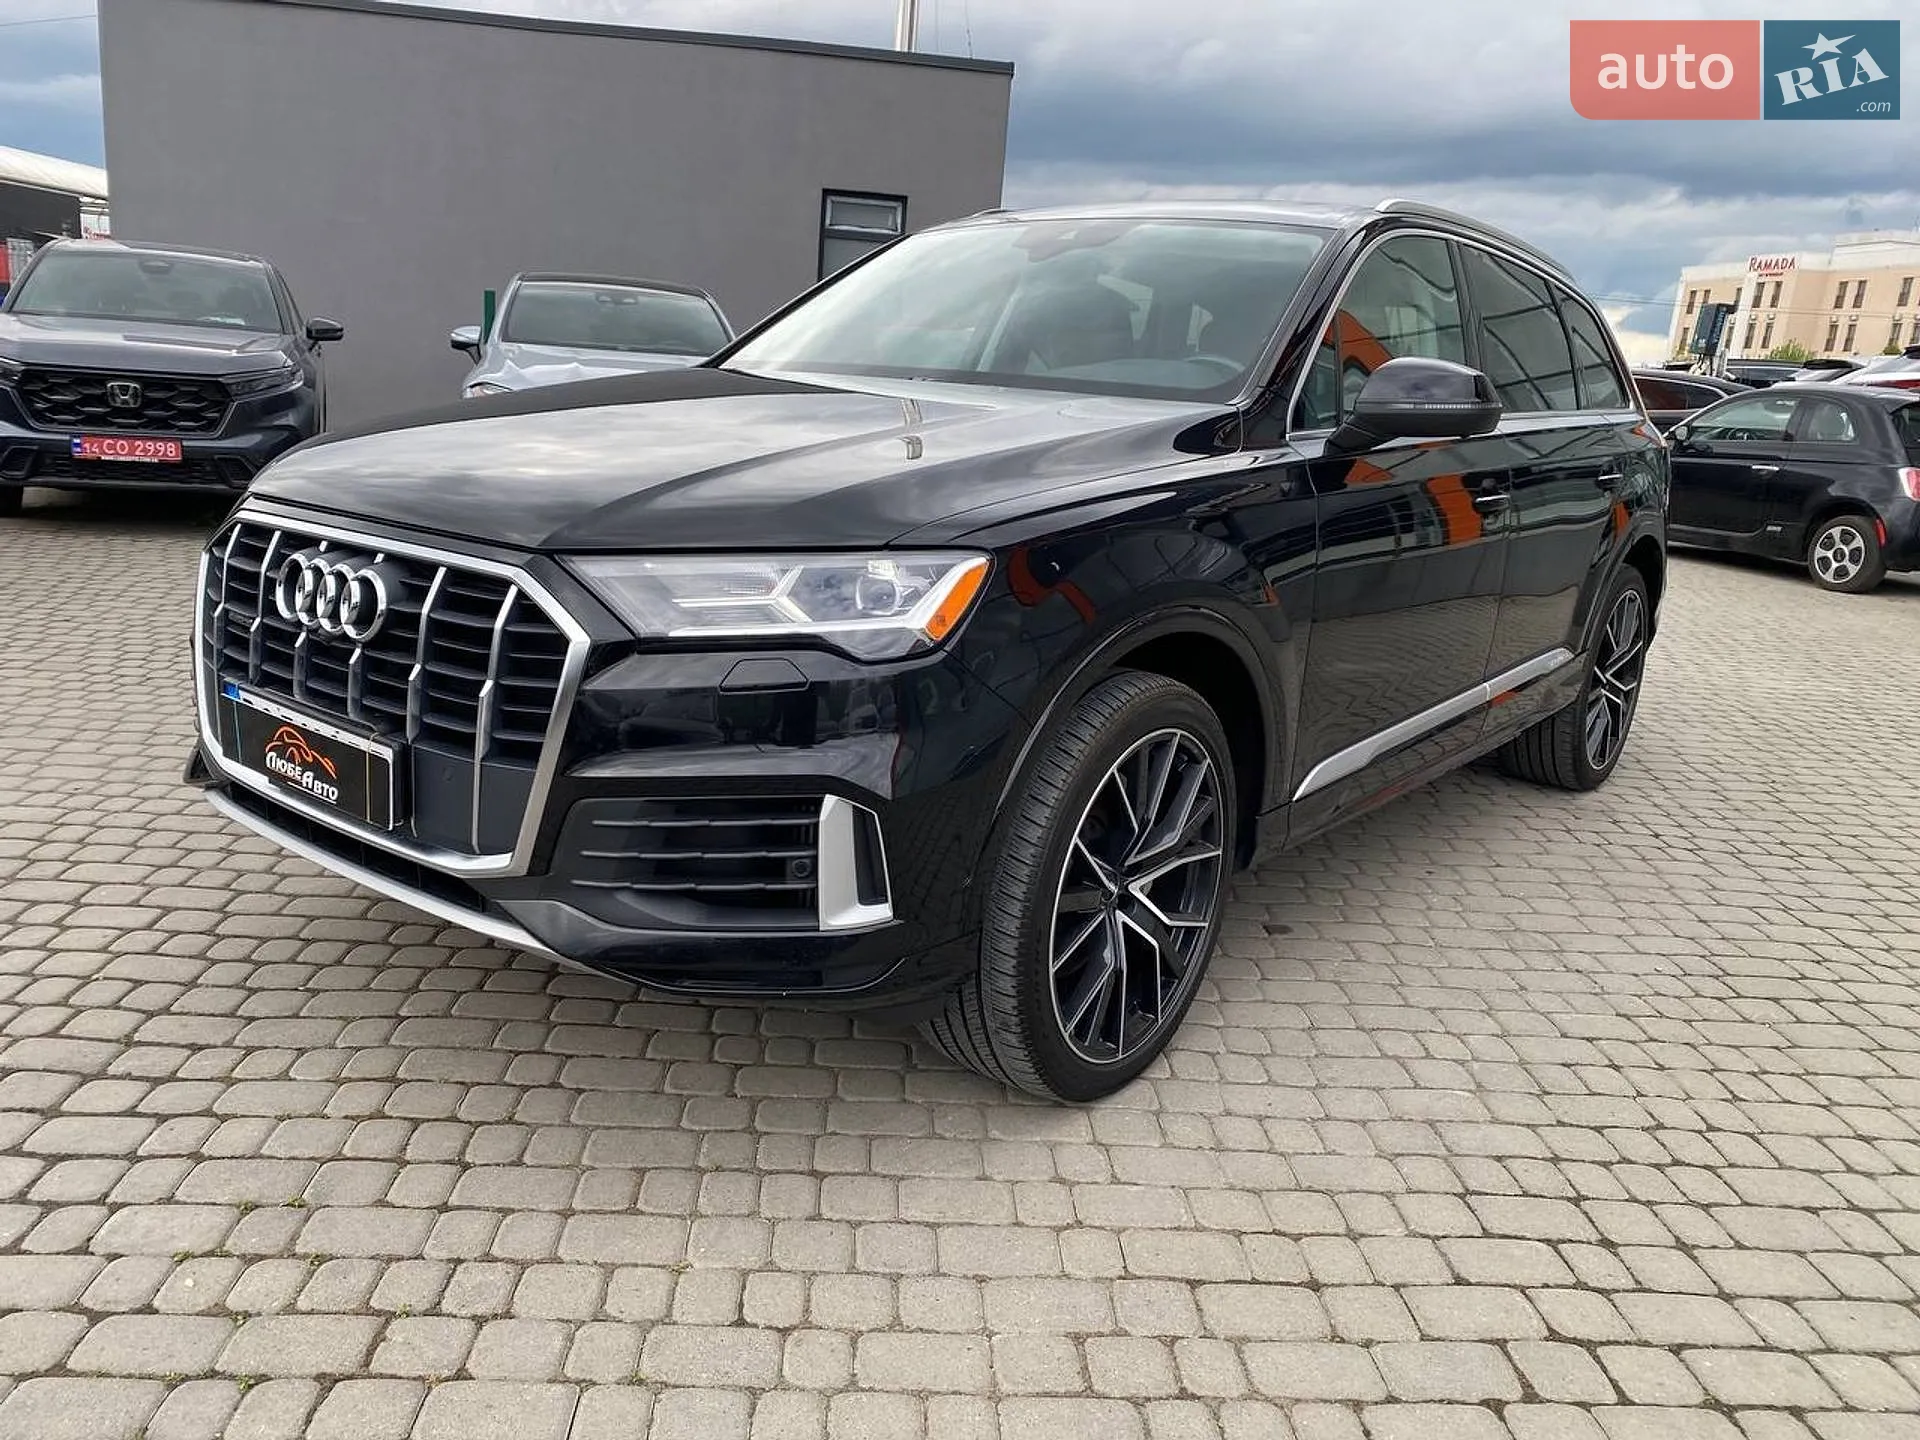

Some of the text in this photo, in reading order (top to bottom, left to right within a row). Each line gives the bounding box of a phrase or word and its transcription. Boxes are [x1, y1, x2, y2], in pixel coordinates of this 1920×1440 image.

[1749, 256, 1796, 272] RAMADA
[83, 442, 99, 455] 14
[135, 441, 176, 457] 2998
